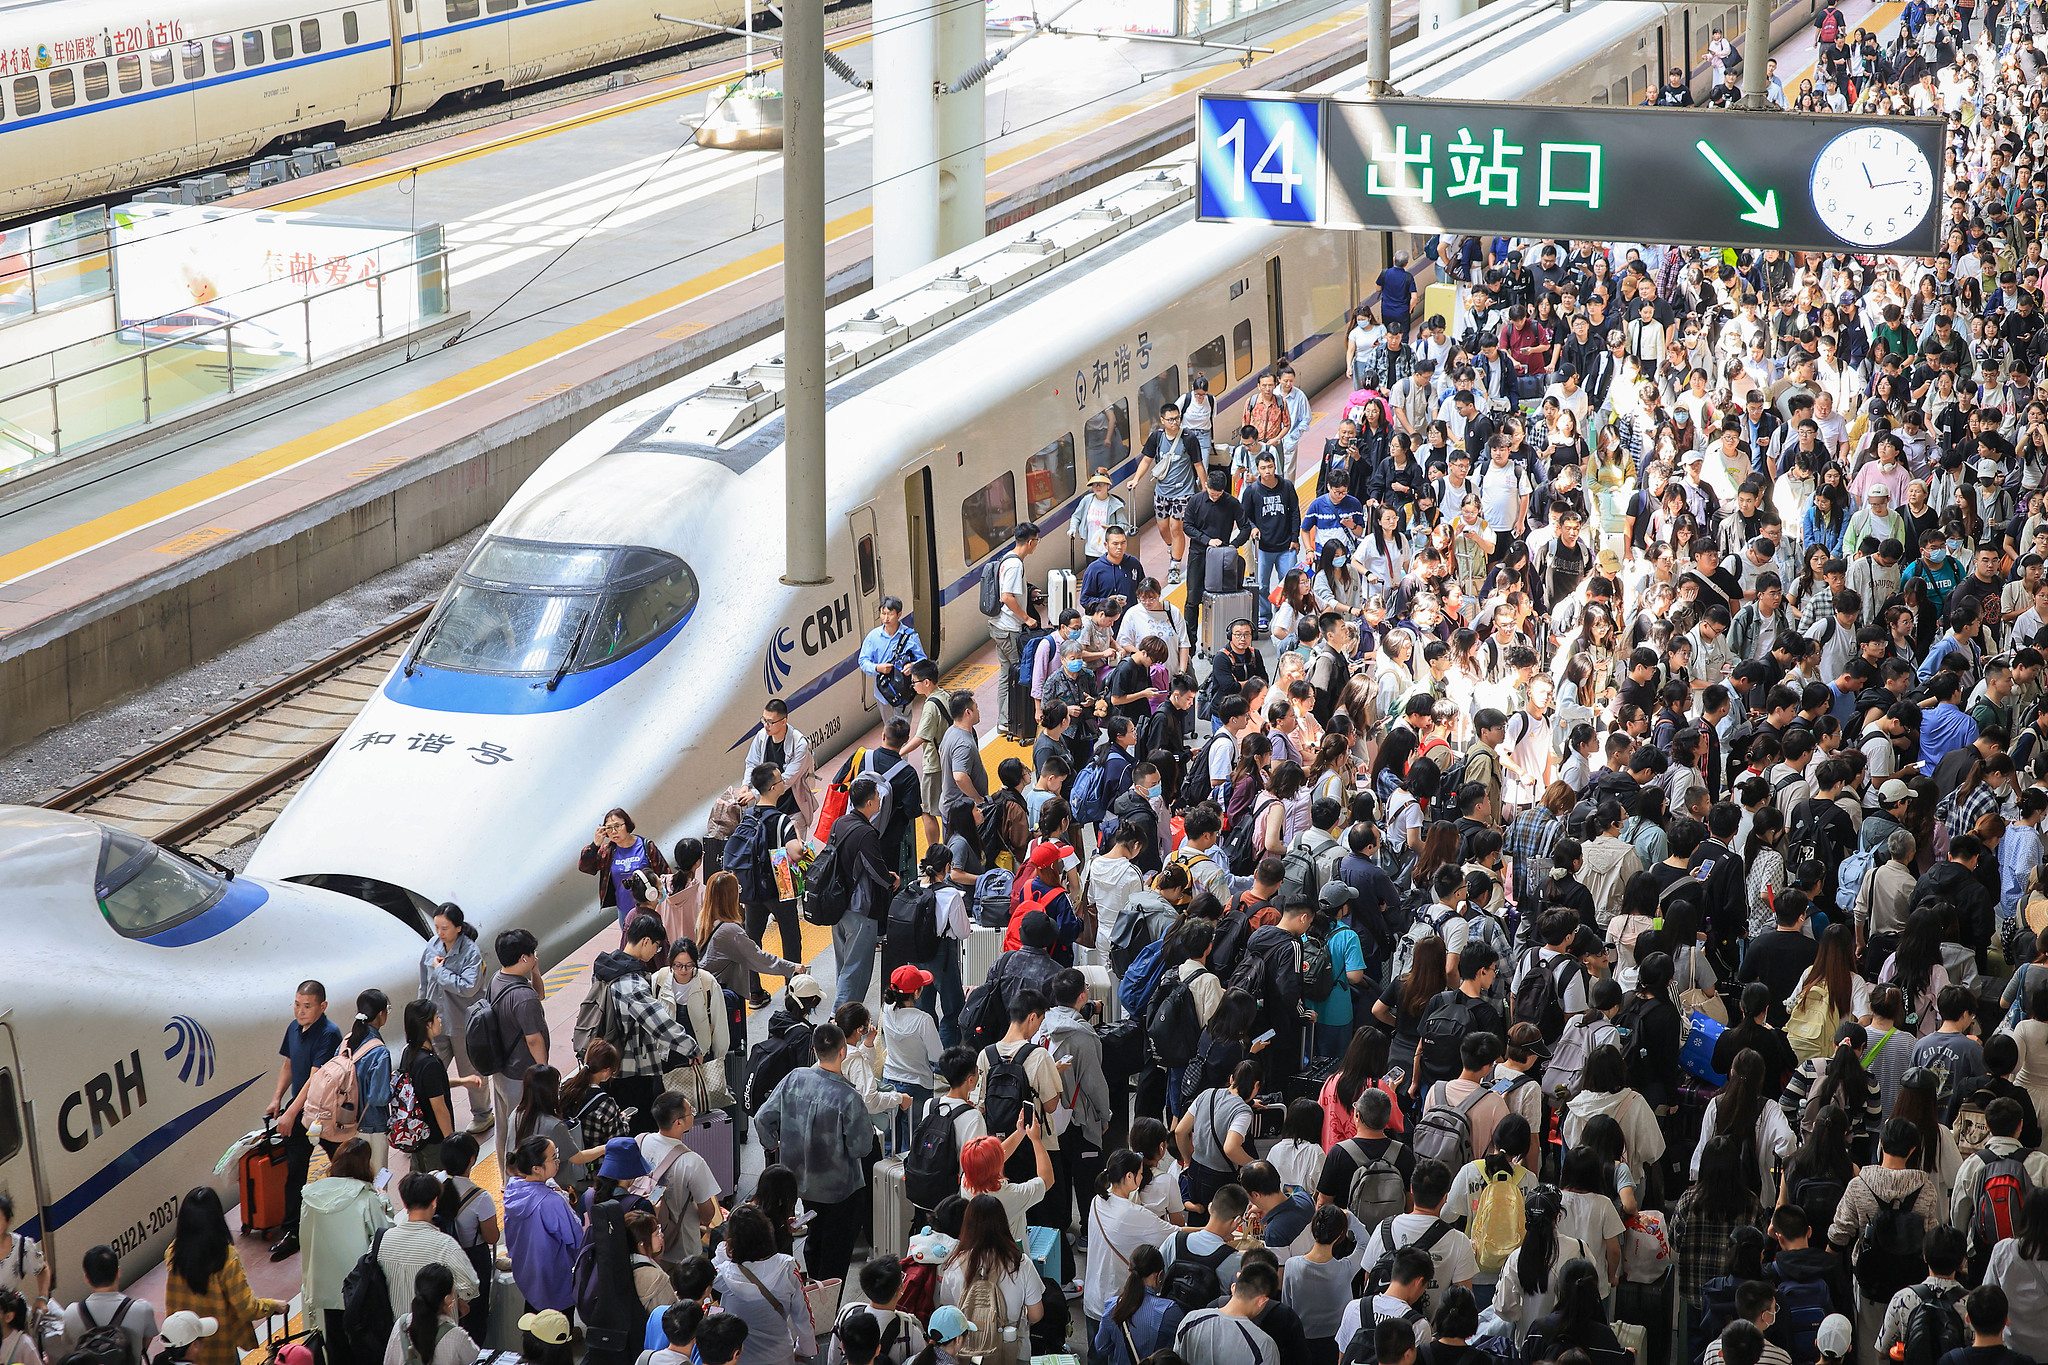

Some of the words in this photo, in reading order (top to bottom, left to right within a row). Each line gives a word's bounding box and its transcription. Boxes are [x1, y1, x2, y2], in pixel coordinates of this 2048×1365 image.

[54, 36, 97, 64] 年份原浆
[113, 26, 143, 54] 古20
[155, 18, 183, 46] 古16
[1869, 135, 1881, 149] 12
[1216, 117, 1303, 204] 14
[1366, 125, 1603, 209] 出站口
[1831, 156, 1843, 170] 10
[1907, 158, 1917, 172] 2
[1822, 177, 1830, 190] 9
[1913, 181, 1922, 195] 3
[1828, 198, 1836, 212] 8
[1904, 204, 1913, 218] 4
[1846, 215, 1855, 228] 7
[1864, 222, 1873, 236] 6
[1887, 218, 1895, 232] 5
[262, 250, 387, 288] 奉献爱心
[1092, 331, 1153, 399] 和谐号
[801, 593, 853, 657] CRH
[809, 715, 841, 750] H2A-2038
[349, 731, 515, 766] 和谐号
[58, 1048, 148, 1153] CRH
[743, 1072, 755, 1110] adidas
